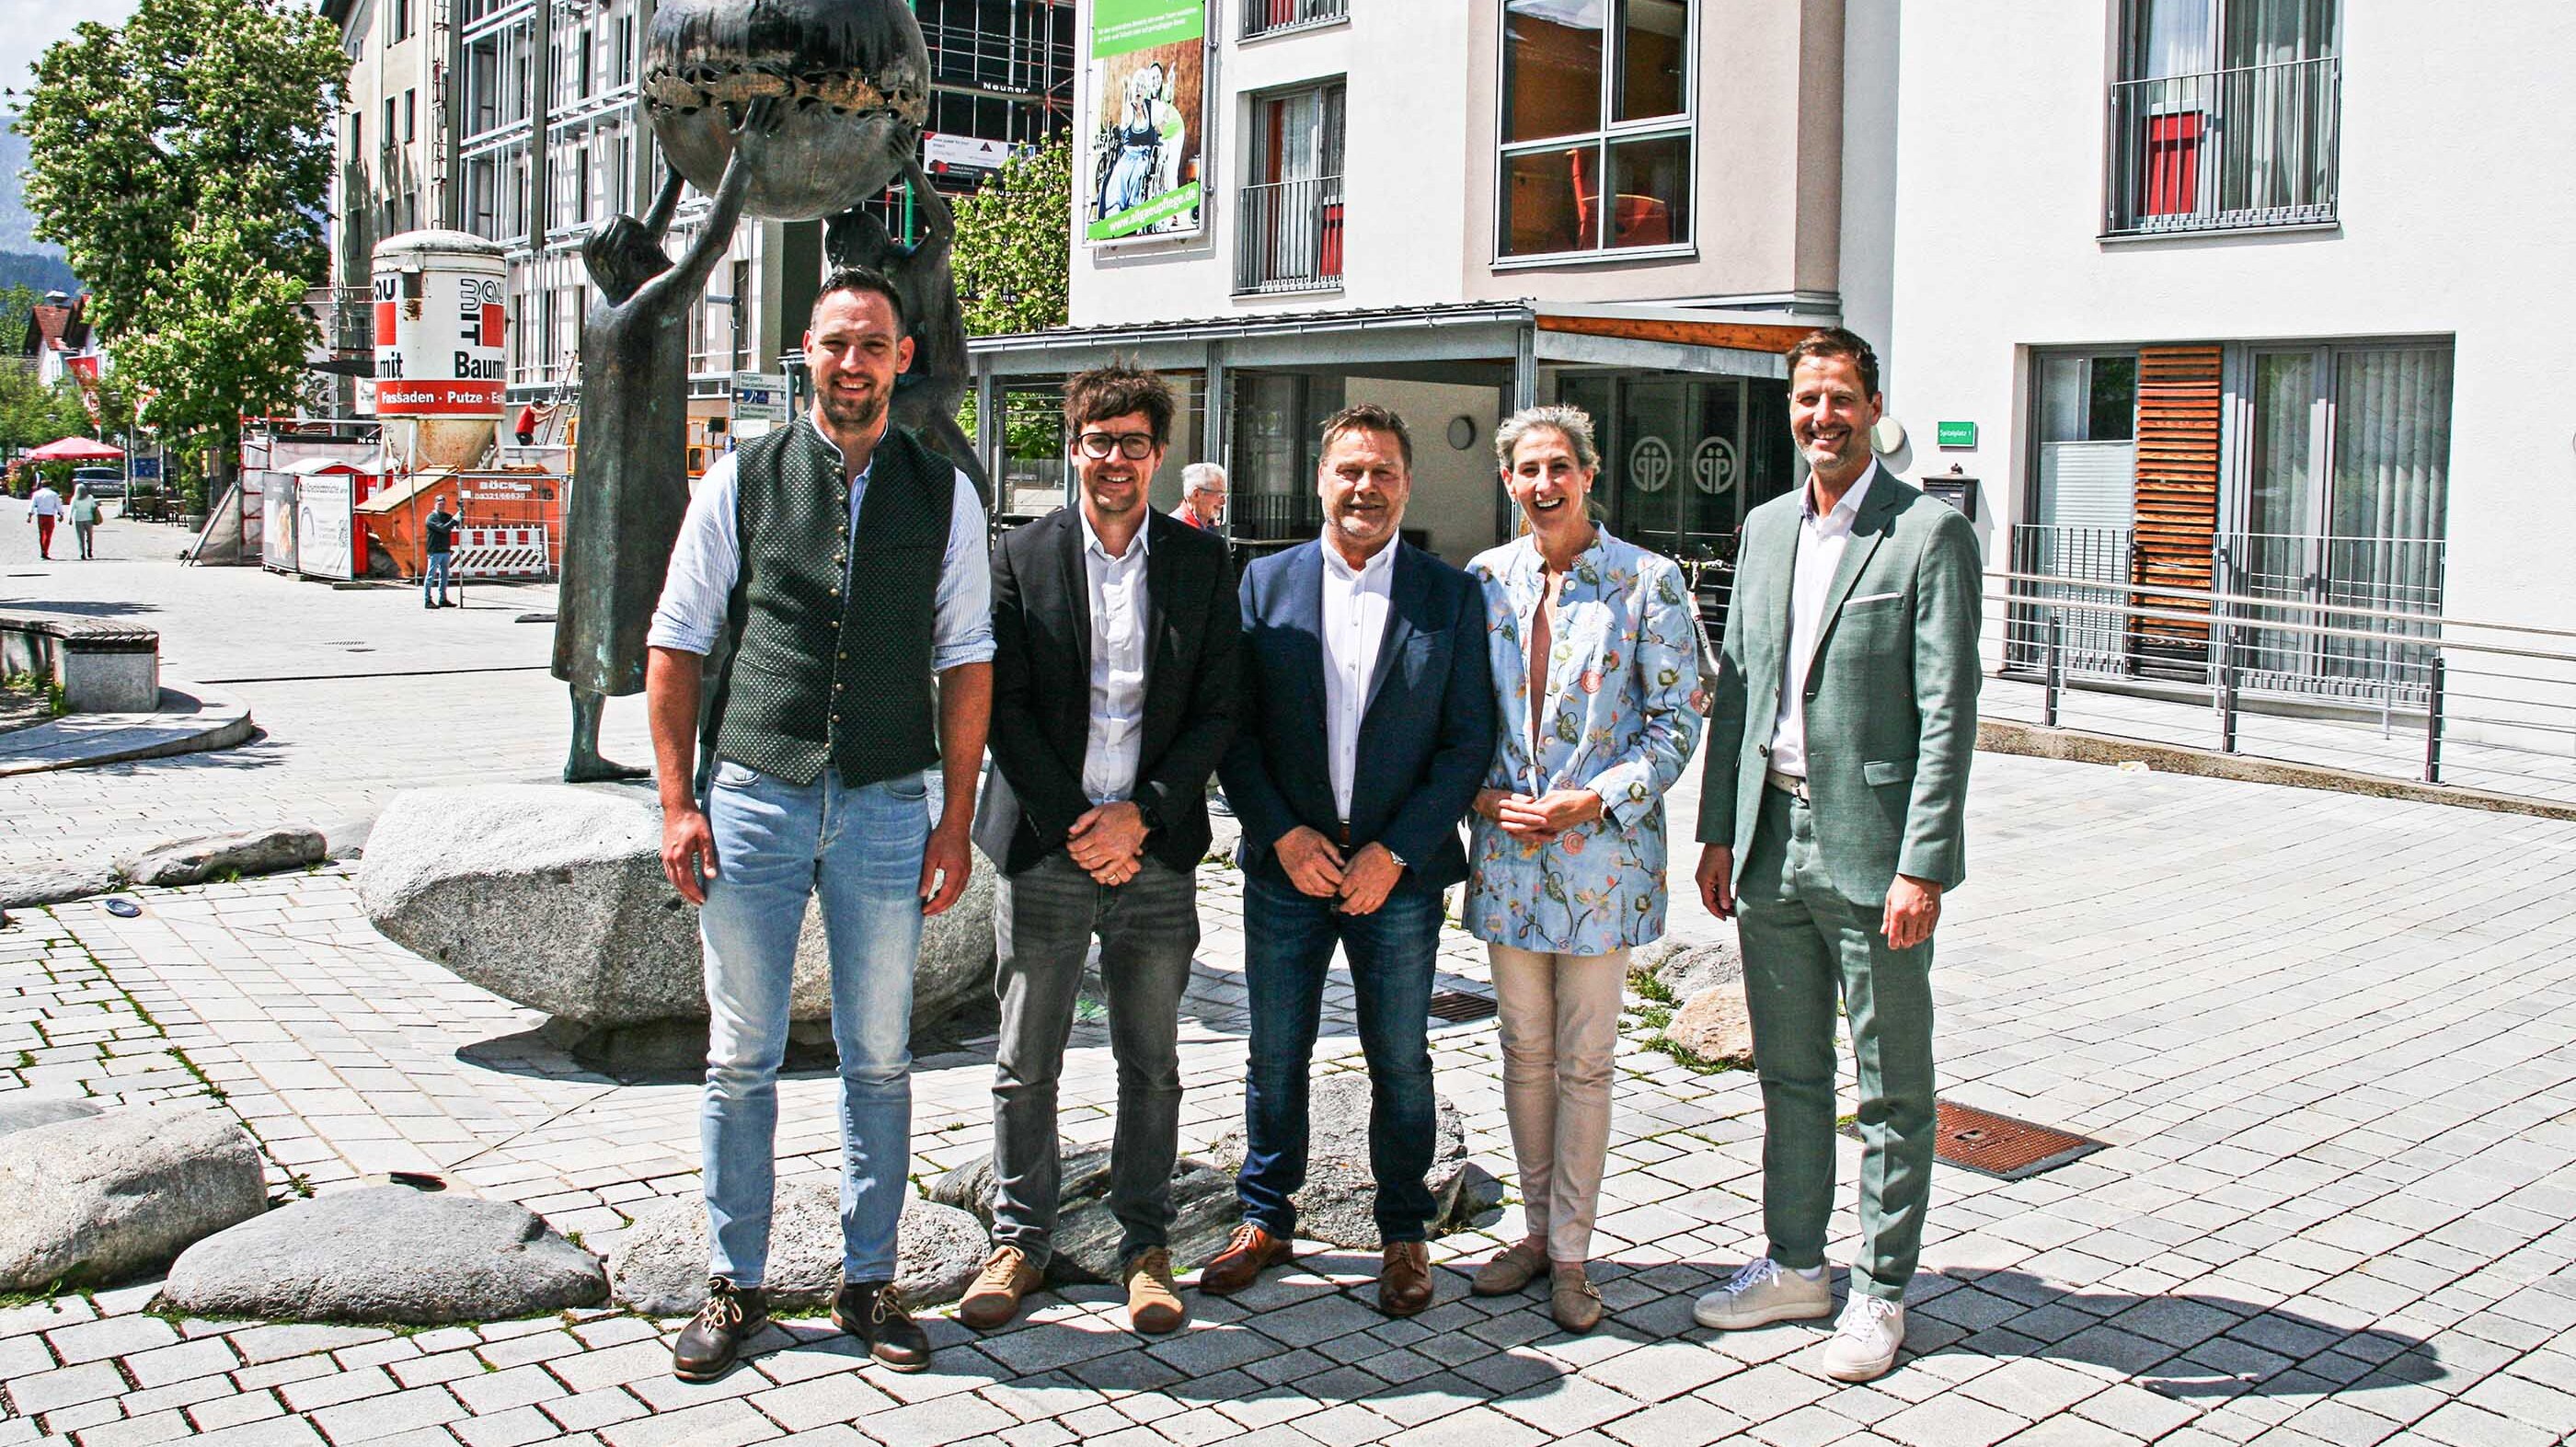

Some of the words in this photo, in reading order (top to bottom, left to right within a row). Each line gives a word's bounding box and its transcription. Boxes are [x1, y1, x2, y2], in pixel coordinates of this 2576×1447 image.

[983, 82, 1029, 94] Neuner
[1108, 188, 1196, 232] www.allgaeupflege.de
[382, 391, 434, 404] Fassaden
[447, 390, 483, 403] Putze
